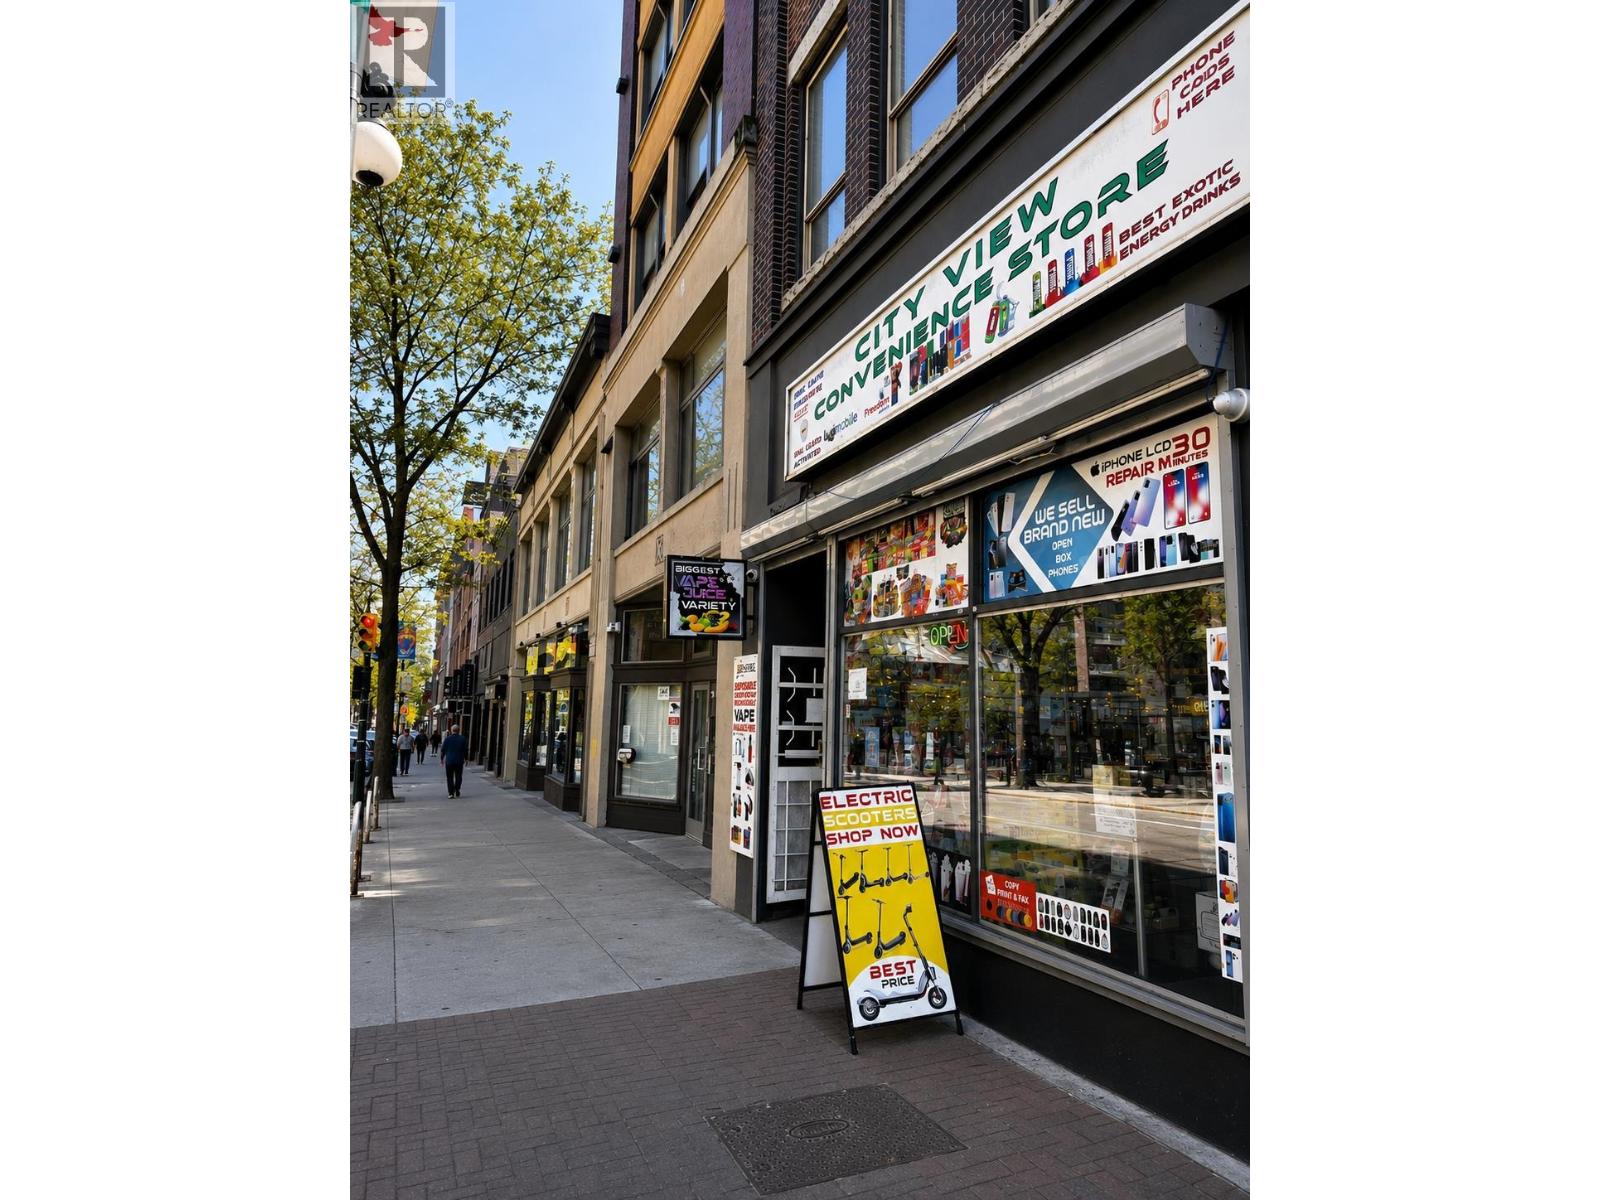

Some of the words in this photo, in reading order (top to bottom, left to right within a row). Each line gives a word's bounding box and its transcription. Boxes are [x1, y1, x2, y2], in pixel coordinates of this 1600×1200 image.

[1172, 30, 1235, 90] PHONE
[1177, 65, 1235, 119] HERE
[1119, 203, 1166, 245] BEST
[1172, 158, 1233, 209] EXOTIC
[1119, 212, 1180, 261] ENERGY
[1182, 171, 1241, 220] DRINKS
[814, 267, 994, 420] CONVENIENCE
[1008, 139, 1169, 282] STORE
[855, 285, 926, 362] CITY
[943, 176, 1058, 287] VIEW
[864, 396, 890, 418] Freedom
[1101, 449, 1142, 473] iPHONE
[1146, 440, 1171, 457] LCD
[1172, 426, 1210, 458] 30
[1106, 460, 1154, 488] REPAIR
[1035, 505, 1055, 525] WE
[1058, 494, 1095, 518] SELL
[1023, 519, 1069, 544] BRAND
[1072, 508, 1105, 532] NEW
[1051, 537, 1073, 550] OPEN
[1055, 552, 1072, 563] BOX
[675, 565, 720, 574] BIGGEST
[1048, 564, 1079, 578] PHONES
[683, 587, 727, 599] JUICE
[681, 600, 736, 610] VARIETY
[930, 623, 968, 646] OPEN
[734, 709, 755, 722] VAPE
[820, 789, 914, 810] ELECTRIC
[823, 807, 917, 827] SCOOTERS
[827, 829, 873, 846] SHOP
[881, 825, 919, 840] NOW
[1005, 880, 1020, 891] COPY
[869, 959, 917, 980] BEST
[881, 975, 916, 989] PRICE
